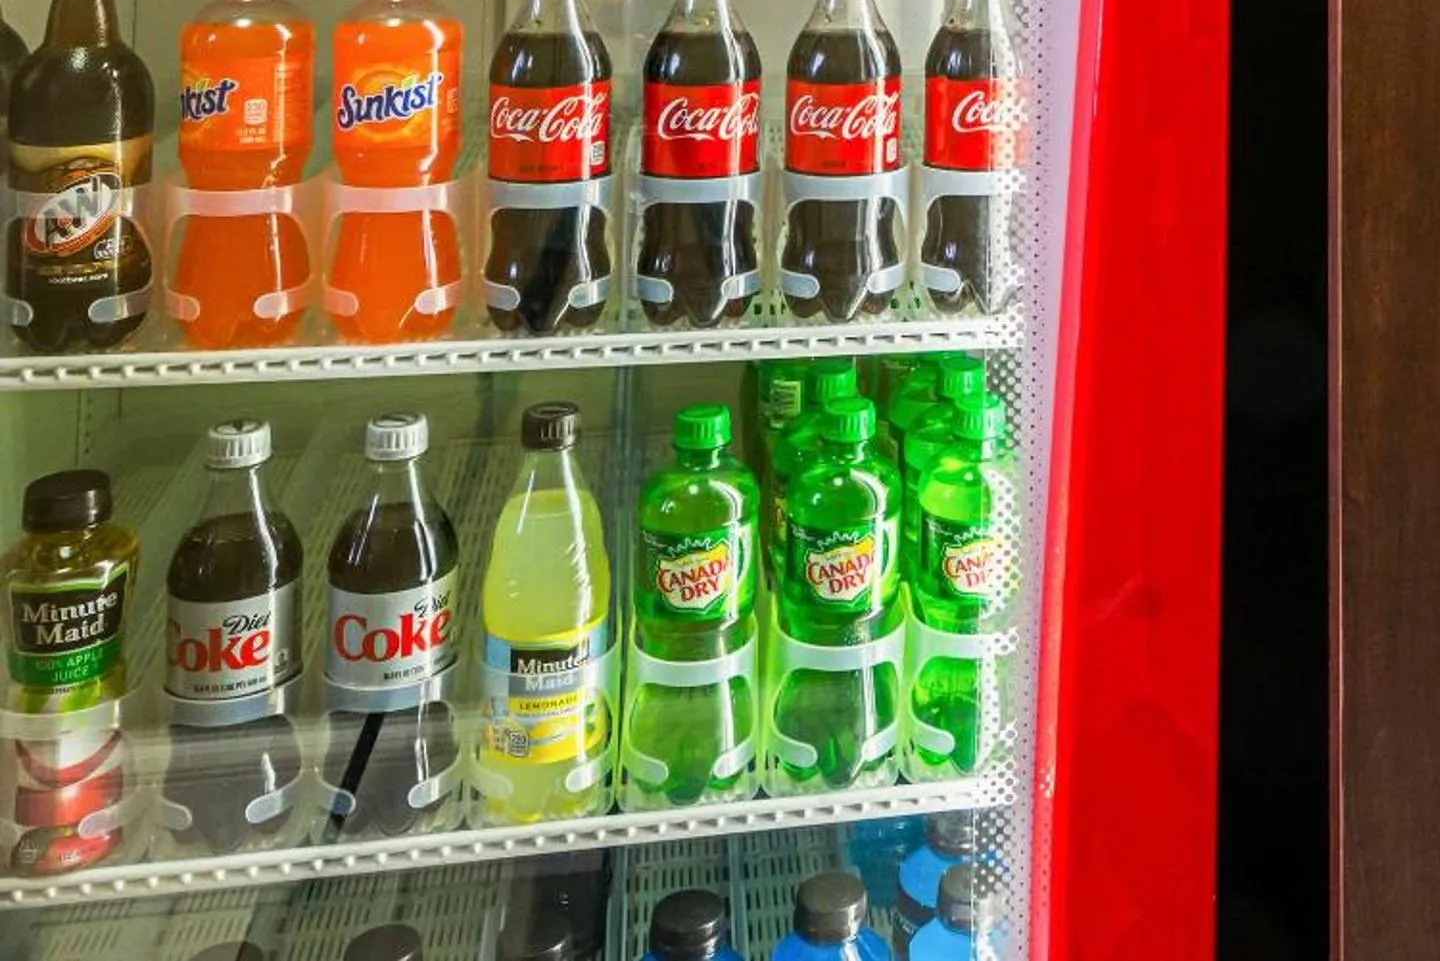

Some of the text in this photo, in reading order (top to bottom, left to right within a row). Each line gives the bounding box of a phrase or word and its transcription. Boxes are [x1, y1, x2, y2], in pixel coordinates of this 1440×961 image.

[181, 80, 236, 121] kist
[337, 72, 442, 131] Sunkist
[490, 93, 608, 142] Coca-Cola
[790, 90, 899, 141] Coca-Cola
[680, 579, 721, 603] DRY
[828, 571, 868, 595] DRY
[22, 591, 118, 623] Minute
[222, 611, 270, 636] Diet
[34, 612, 106, 645] Maid
[334, 609, 451, 663] Coke
